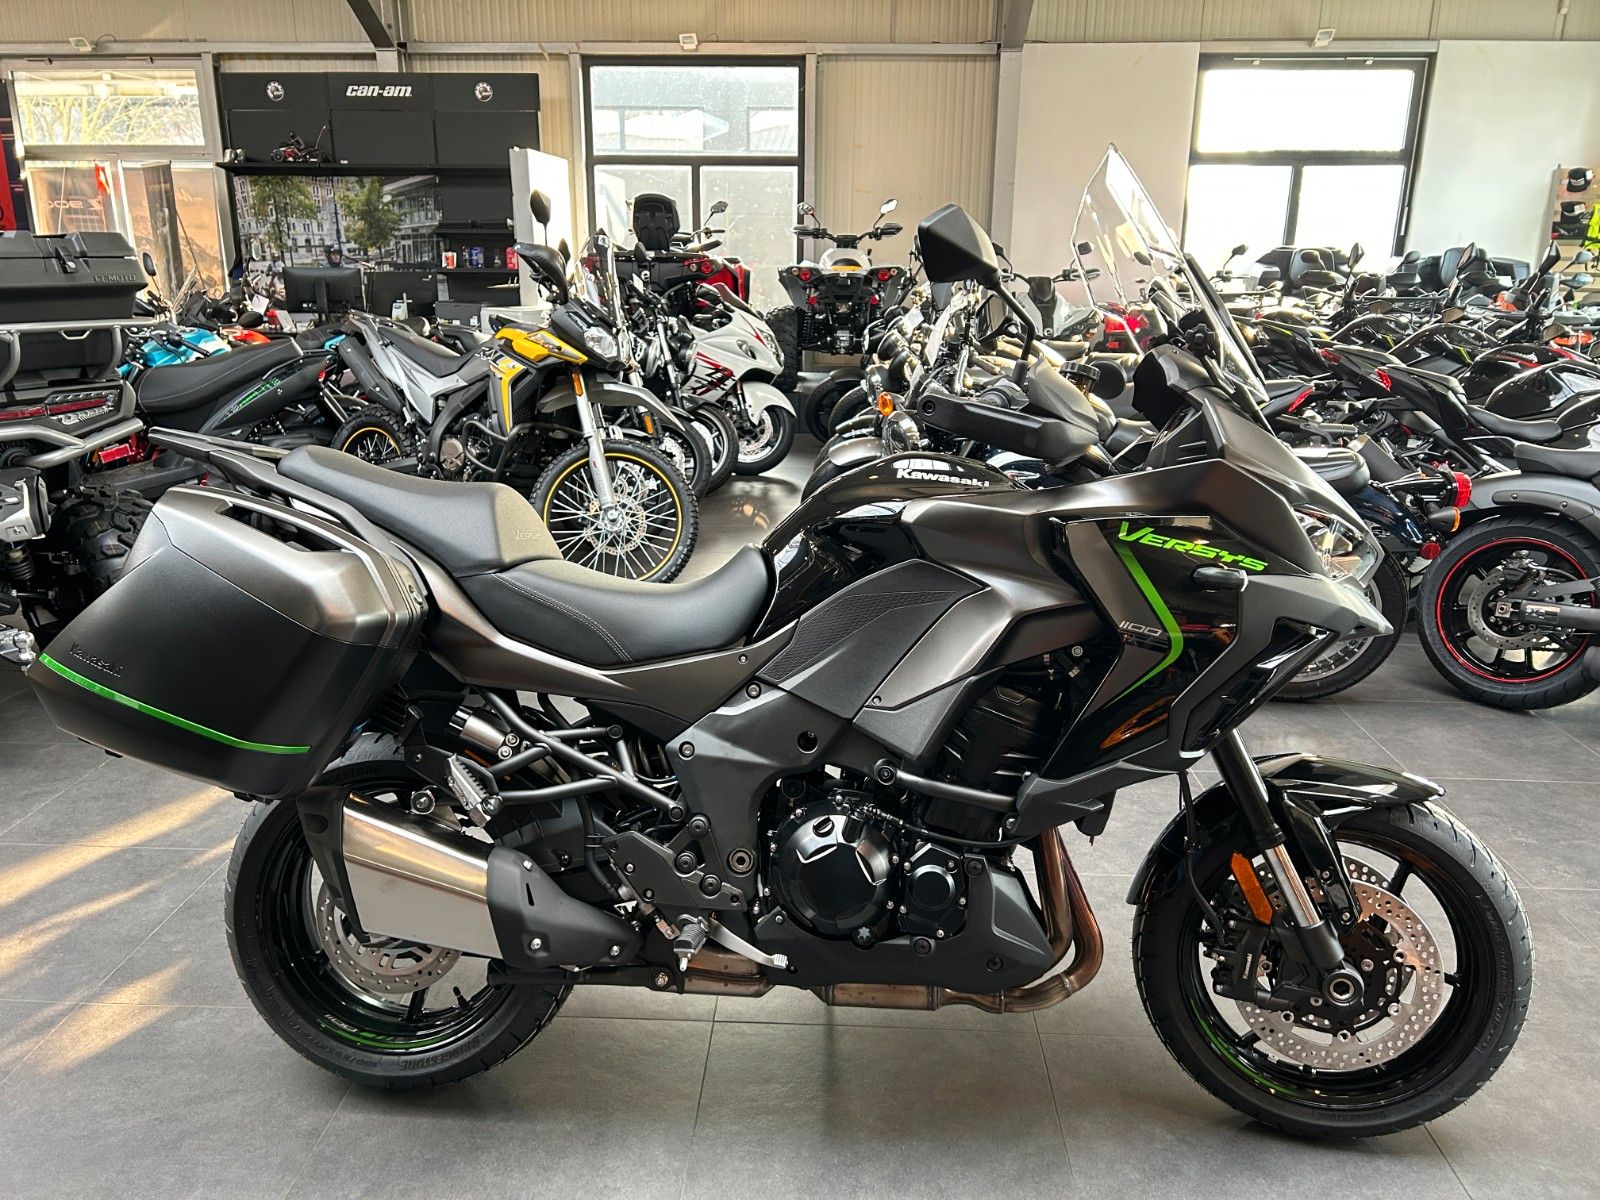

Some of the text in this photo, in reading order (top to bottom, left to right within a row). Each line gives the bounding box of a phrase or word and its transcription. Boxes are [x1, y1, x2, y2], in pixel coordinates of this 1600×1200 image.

[345, 85, 413, 97] can-am
[896, 468, 990, 488] Kawasaki
[1118, 620, 1163, 637] 1100
[70, 641, 124, 678] Kawasaki
